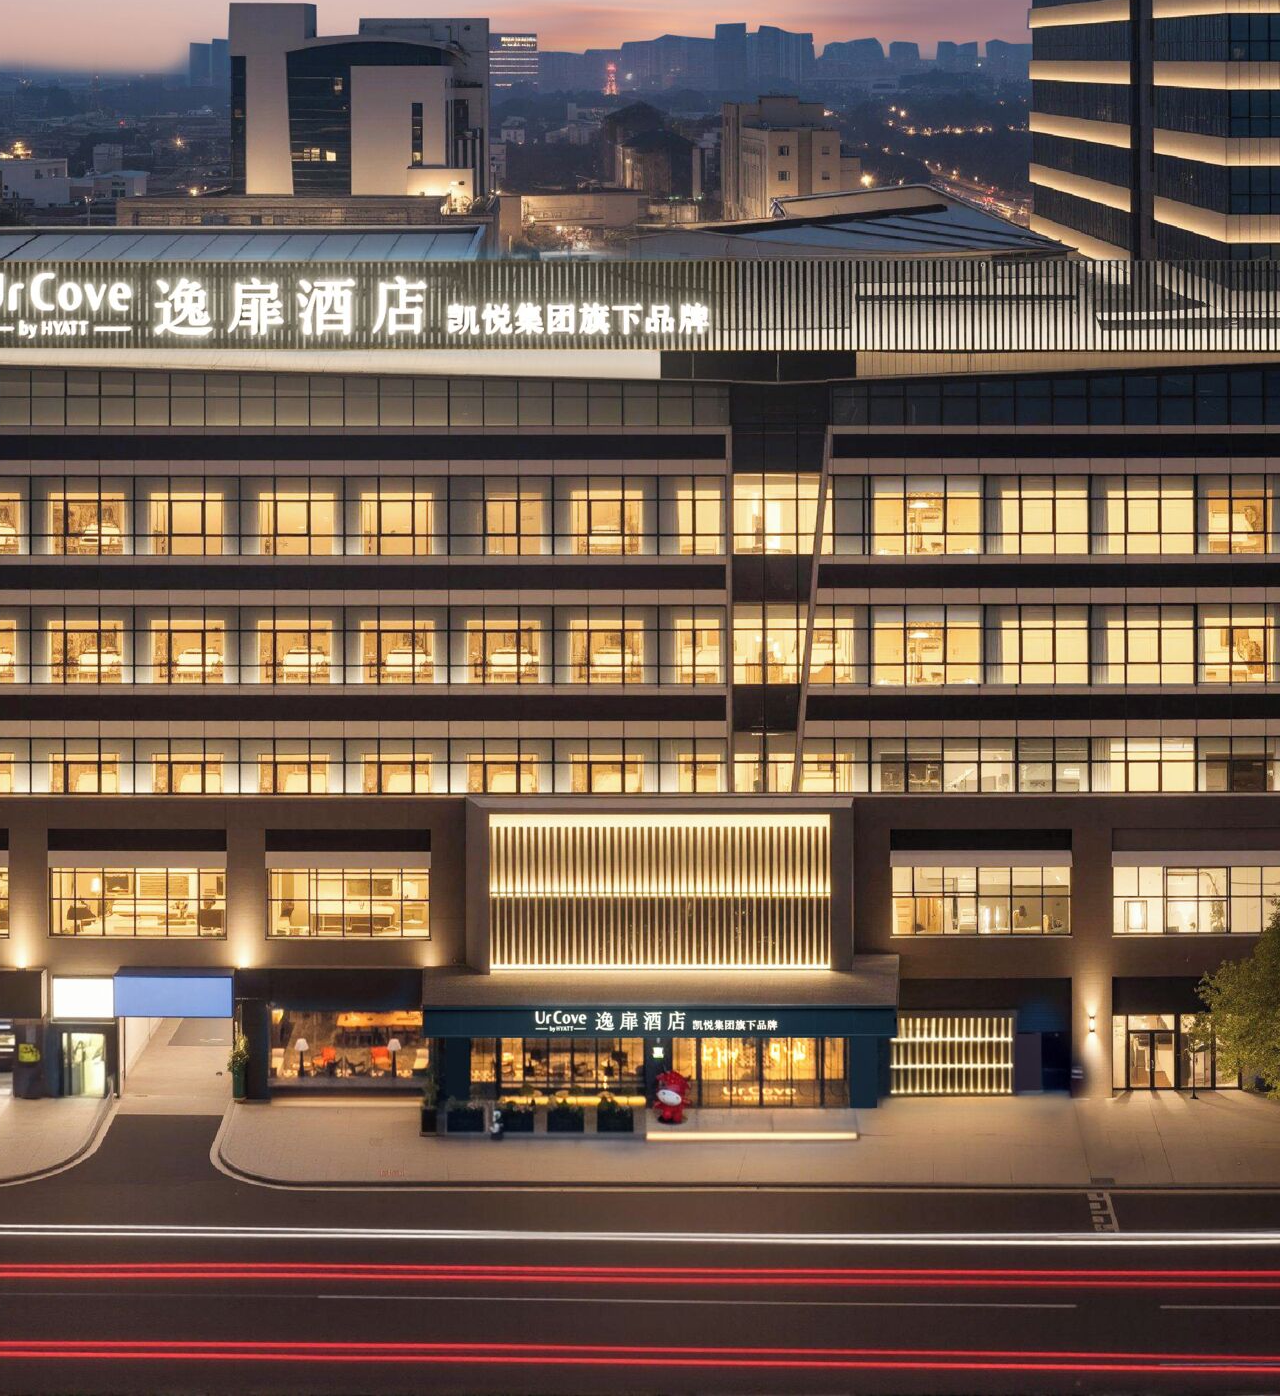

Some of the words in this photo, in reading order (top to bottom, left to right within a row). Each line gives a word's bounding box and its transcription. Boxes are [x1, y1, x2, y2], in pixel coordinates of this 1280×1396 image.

[154, 276, 427, 336] 逸扉酒店
[447, 302, 709, 335] 凯悦集团旗下品牌
[18, 320, 38, 339] by
[41, 320, 89, 336] HYATT
[535, 1010, 587, 1024] UrCove
[594, 1010, 686, 1032] 逸扉酒店
[692, 1019, 778, 1031] 凯悦集团旗下品牌
